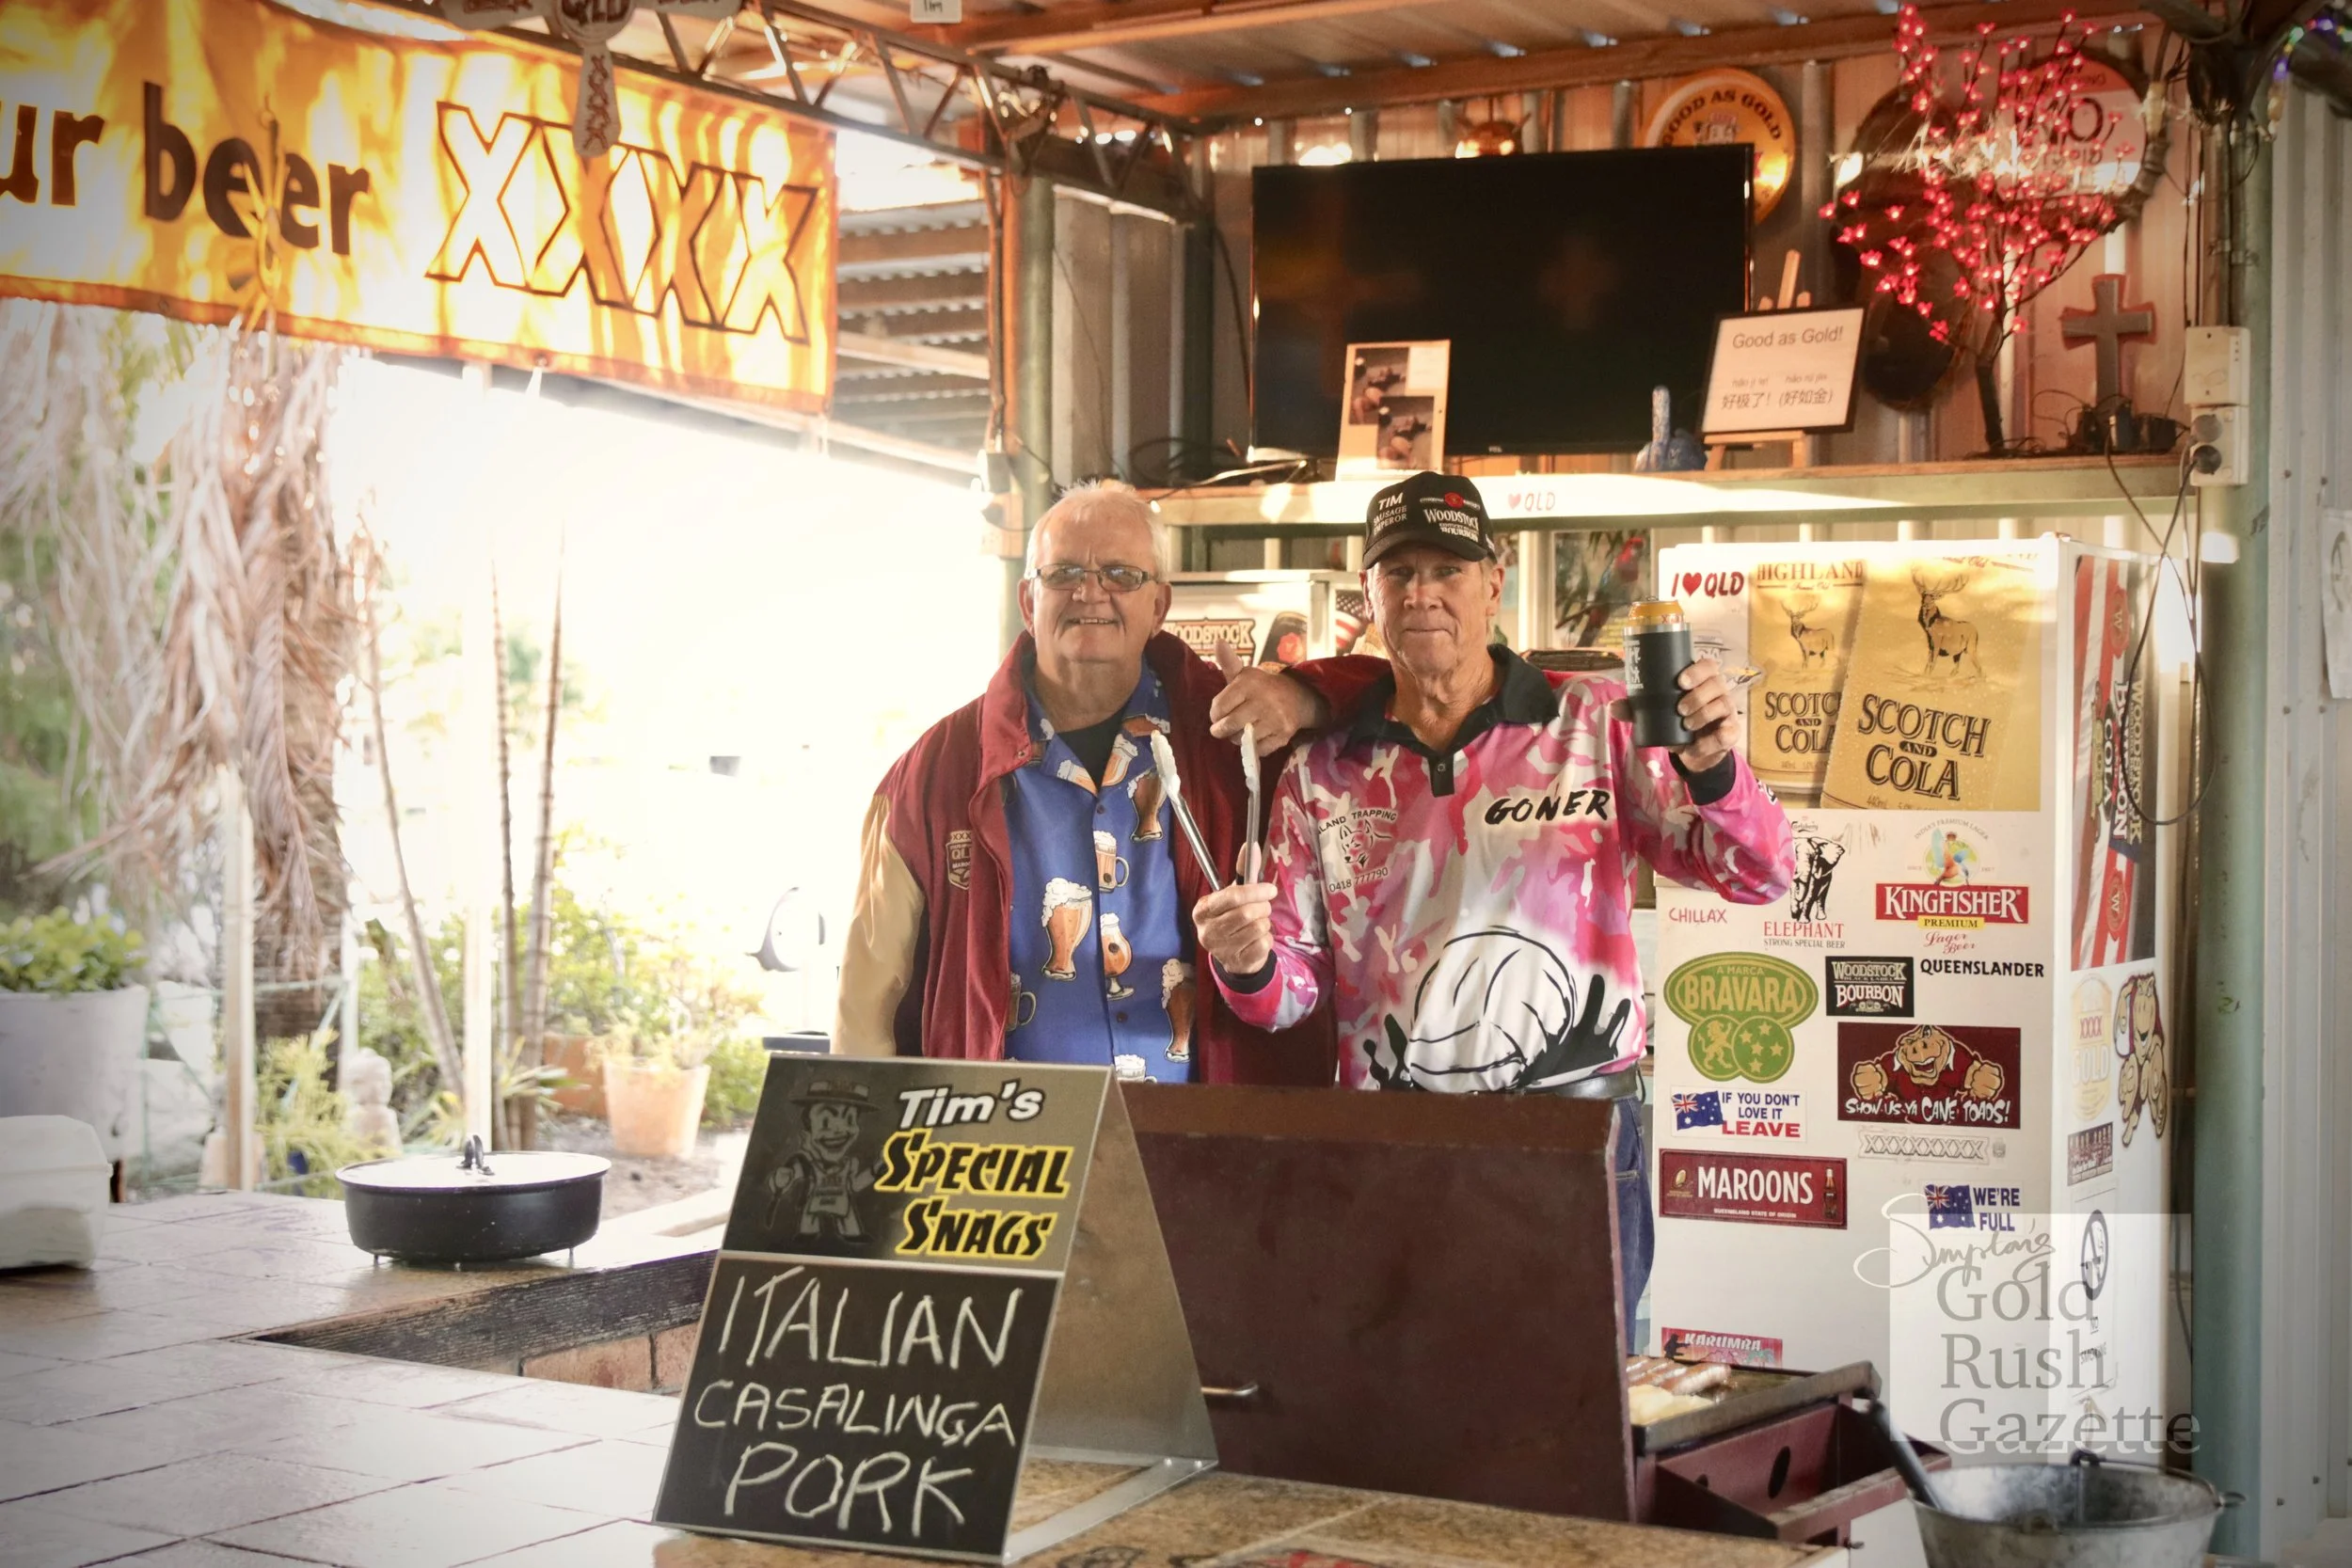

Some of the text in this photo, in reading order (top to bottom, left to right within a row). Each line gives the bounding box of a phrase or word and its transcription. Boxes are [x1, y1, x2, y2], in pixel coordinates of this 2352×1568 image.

[1711, 90, 1737, 103] AS
[1741, 94, 1781, 140] GOLD
[144, 81, 370, 256] beer
[424, 101, 816, 344] XXXX
[1732, 325, 1844, 349] Good as Gold!
[1378, 491, 1404, 511] TIM
[1374, 504, 1407, 527] SAUSAGE
[1374, 513, 1407, 536] EMPEROR
[1422, 508, 1480, 531] WOODSTOCK
[1671, 571, 1745, 600] I QLD
[1857, 693, 1992, 758] SCOTCH
[1903, 743, 1934, 757] AND
[2104, 717, 2114, 805] COLA
[1866, 743, 1961, 801] COLA
[1351, 809, 1397, 821] TRAPPING
[1485, 789, 1611, 825] GONER
[1936, 817, 1970, 827] PREMIUM
[952, 847, 971, 861] QL
[1329, 866, 1389, 893] 0418 777790
[1669, 907, 1727, 924] CHILLAX
[1884, 886, 2024, 923] KINGFISHER
[1764, 921, 1845, 939] ELEPHANT
[1924, 918, 1979, 928] PREMIUM
[1764, 939, 1846, 949] STRONG SPECIAL BEER
[1923, 931, 1968, 948] Lager
[1942, 942, 1977, 954] Beer
[1727, 967, 1765, 975] MARCA
[1831, 961, 1908, 981] WOODSTOCK
[1920, 958, 2044, 977] QUEENSLANDER
[1684, 974, 1801, 1013] BRAVARA
[1835, 984, 1905, 1008] BOURBON
[2080, 1015, 2103, 1039] XXXX
[897, 1079, 1045, 1129] Tim's
[1722, 1091, 1801, 1106] IF YOU DON'T
[1738, 1107, 1783, 1119] LOVE IT
[1905, 1098, 1917, 1117] YA
[1921, 1096, 1957, 1122] CANE
[1963, 1098, 2011, 1125] TOADS!
[1722, 1120, 1801, 1138] LEAVE
[874, 1129, 1074, 1198] SPECIAL
[1698, 1166, 1814, 1205] MAROONS
[1973, 1188, 2021, 1207] WE'RE
[895, 1197, 1058, 1258] SNAGS
[1979, 1212, 2015, 1232] FULL
[718, 1266, 1024, 1370] ITALIAN
[693, 1381, 1016, 1448] CASALINGA
[723, 1441, 974, 1537] PORK
